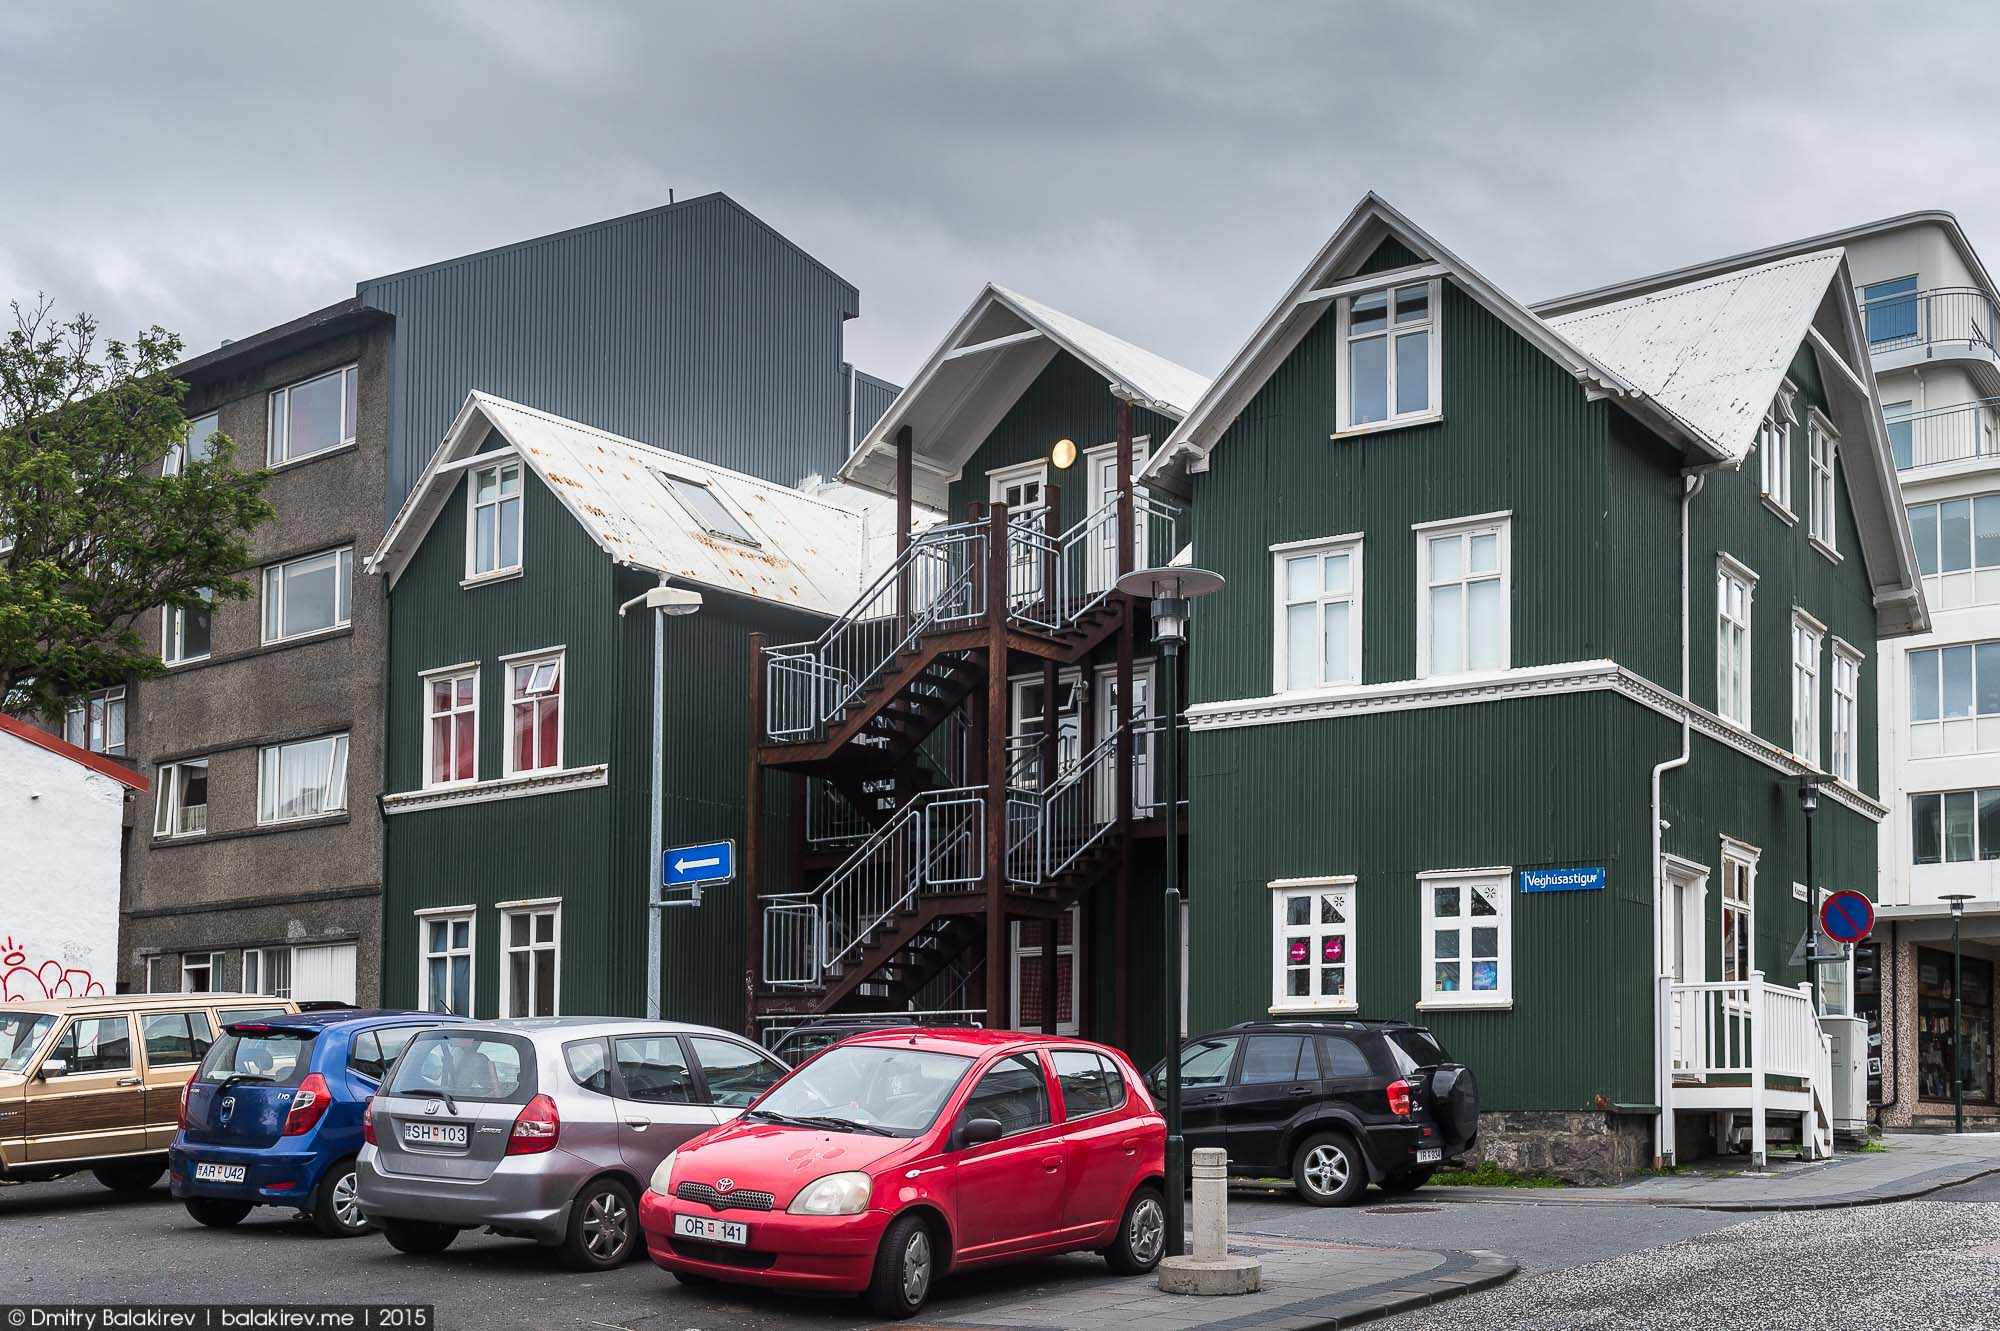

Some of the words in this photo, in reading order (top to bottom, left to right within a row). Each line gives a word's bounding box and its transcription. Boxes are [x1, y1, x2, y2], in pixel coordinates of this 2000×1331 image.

[412, 1125, 430, 1139] SH
[441, 1128, 465, 1142] 103
[202, 1166, 216, 1177] AR
[224, 1167, 244, 1180] U42
[685, 1218, 704, 1235] OR
[721, 1223, 740, 1240] 141
